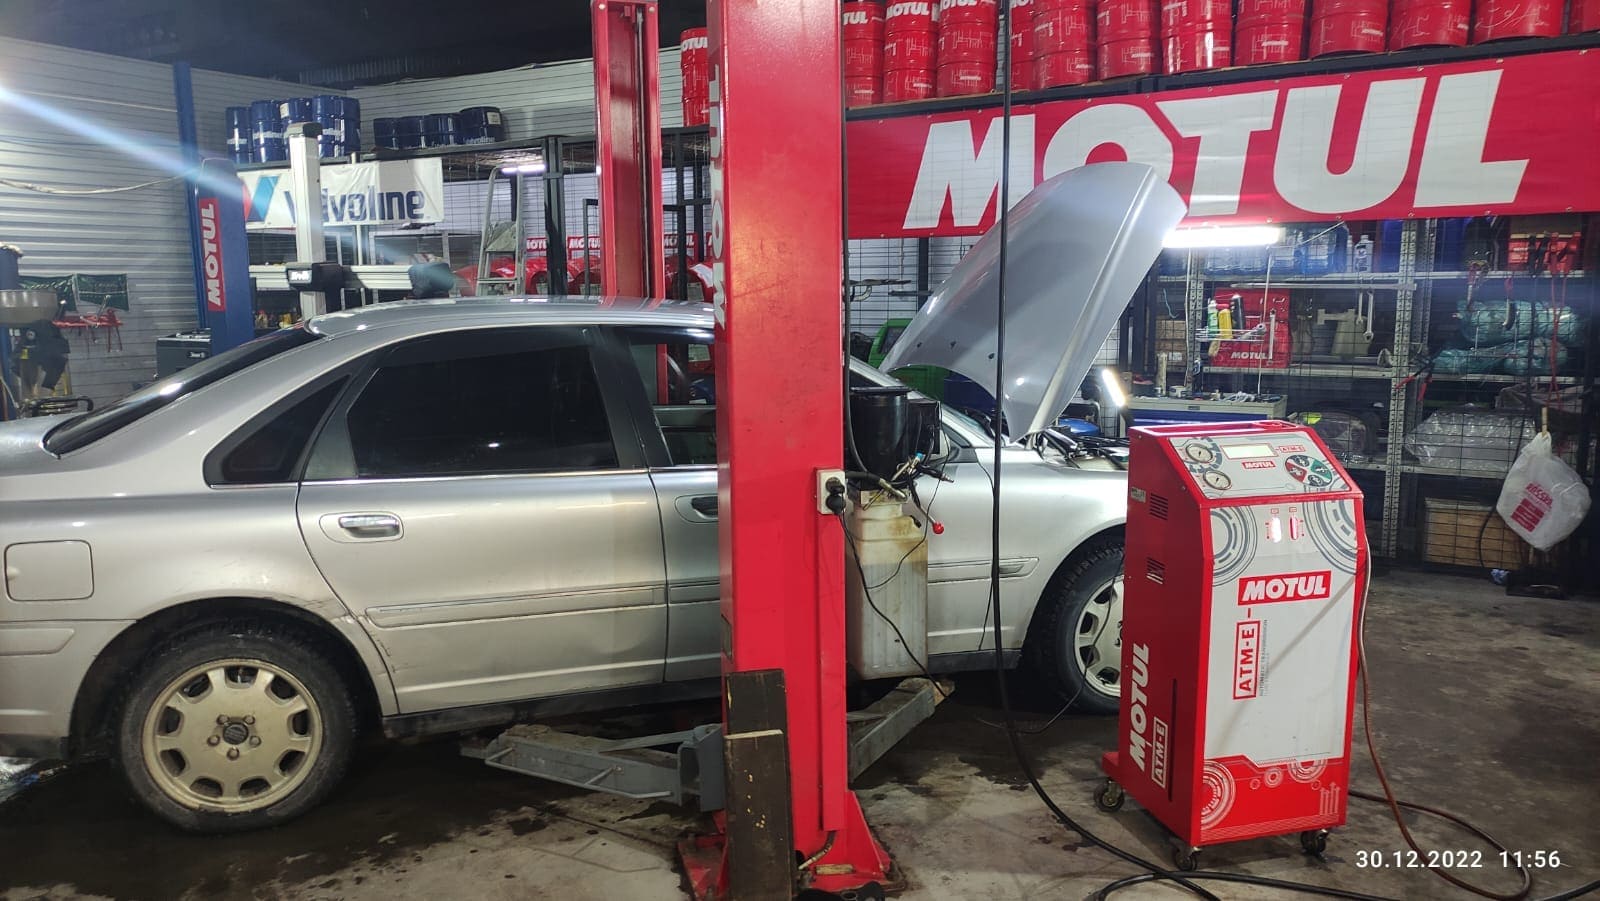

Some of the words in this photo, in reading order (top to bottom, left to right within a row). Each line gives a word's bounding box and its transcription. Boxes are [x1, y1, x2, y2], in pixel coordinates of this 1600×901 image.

[903, 69, 1530, 229] MOTUL
[709, 64, 726, 331] MOTUL
[201, 203, 222, 306] MOTUL
[1231, 351, 1268, 360] MOTUL
[1244, 461, 1275, 469] MOTUL
[1242, 575, 1327, 602] MOTUL
[1239, 628, 1255, 692] ATM-E
[1129, 643, 1149, 773] MOTUL
[1154, 721, 1165, 781] ATM-E
